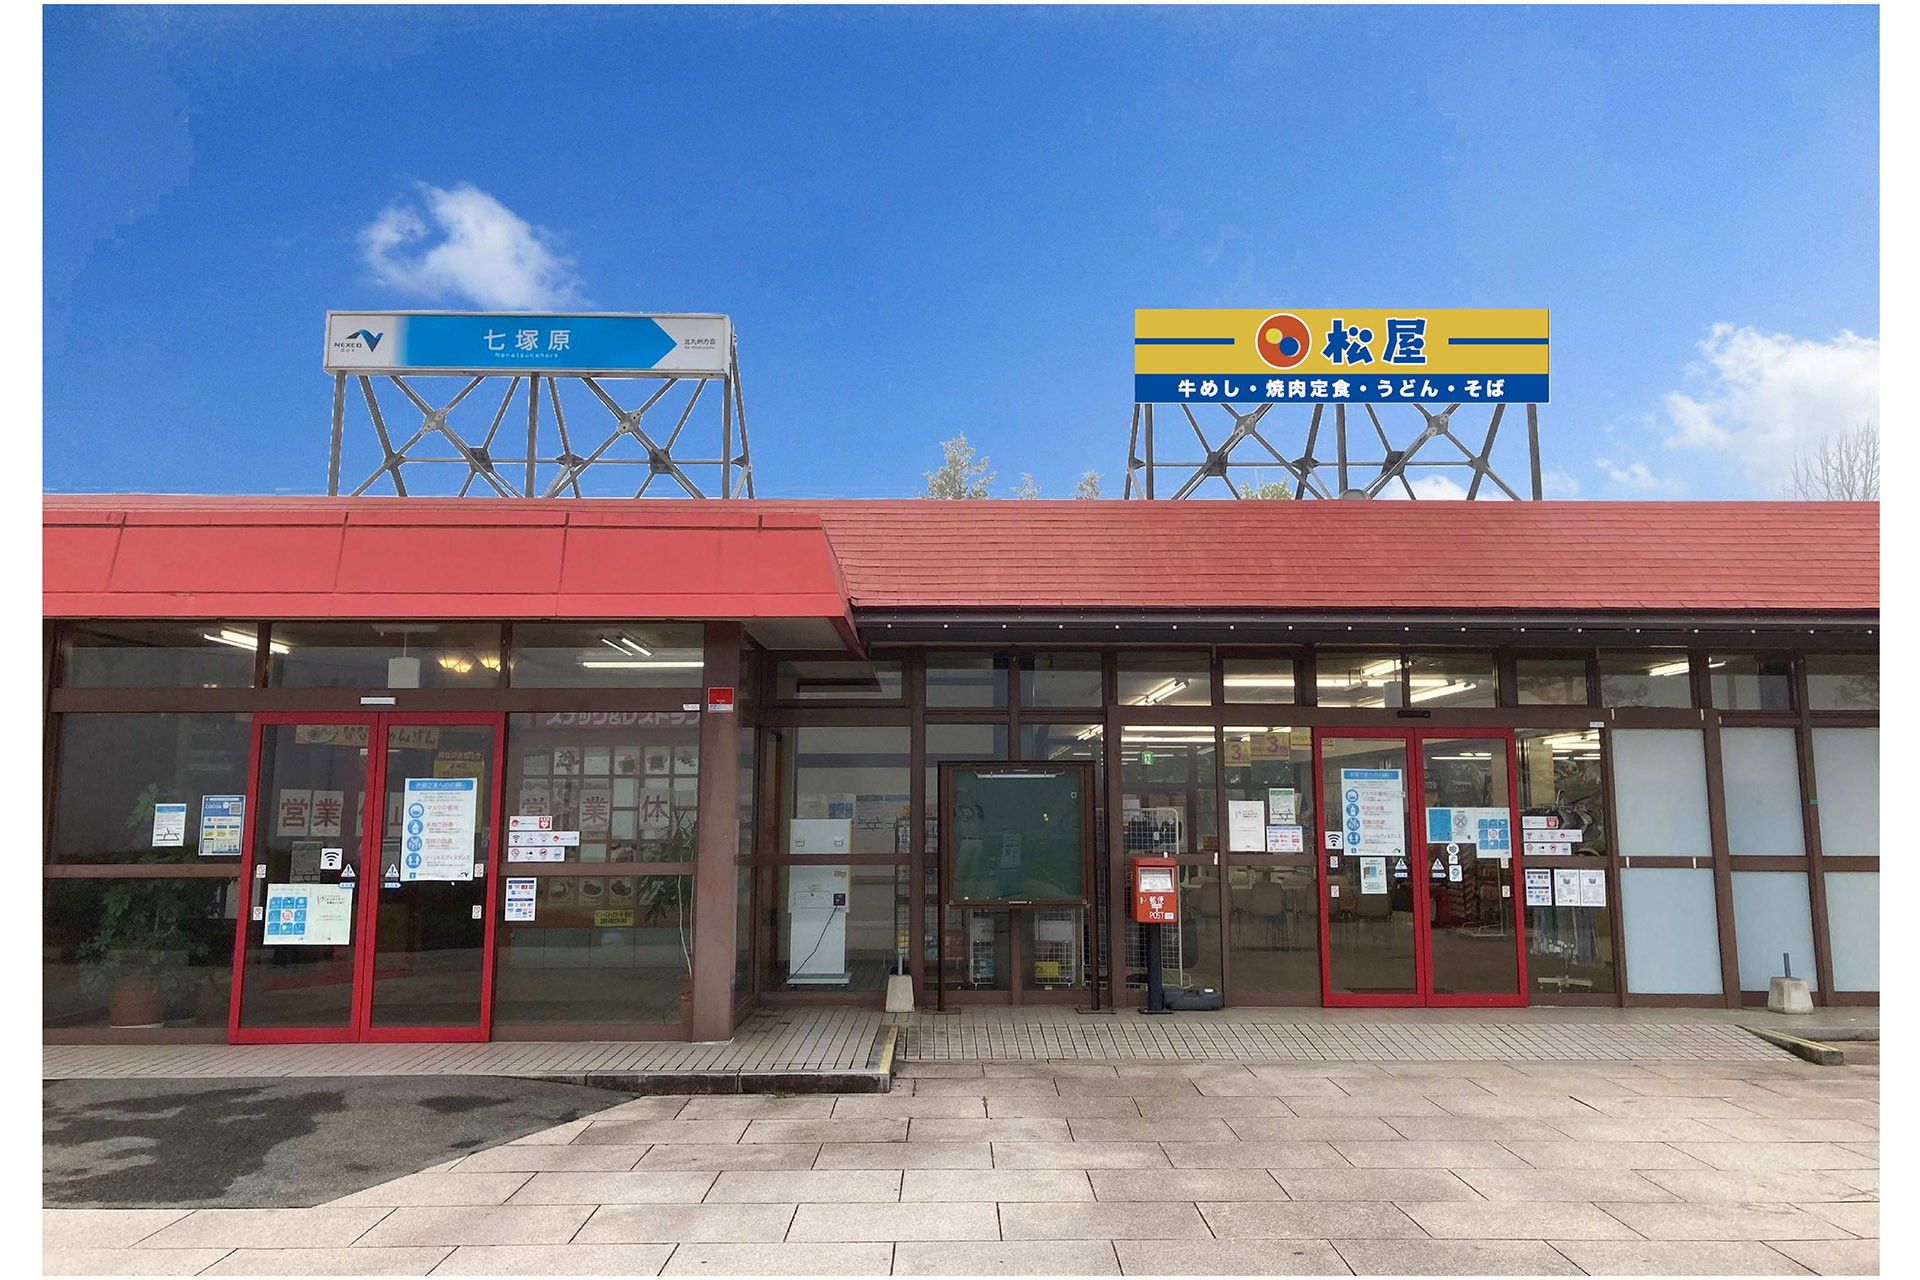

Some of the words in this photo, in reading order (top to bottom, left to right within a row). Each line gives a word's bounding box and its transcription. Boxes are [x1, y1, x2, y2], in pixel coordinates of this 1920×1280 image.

[483, 328, 571, 351] 七塚原
[1320, 317, 1427, 366] 松屋
[1178, 379, 1505, 398] 牛めし・焼肉定食・うどん・そば
[1149, 895, 1165, 905] 郵便
[1149, 911, 1165, 920] POST
